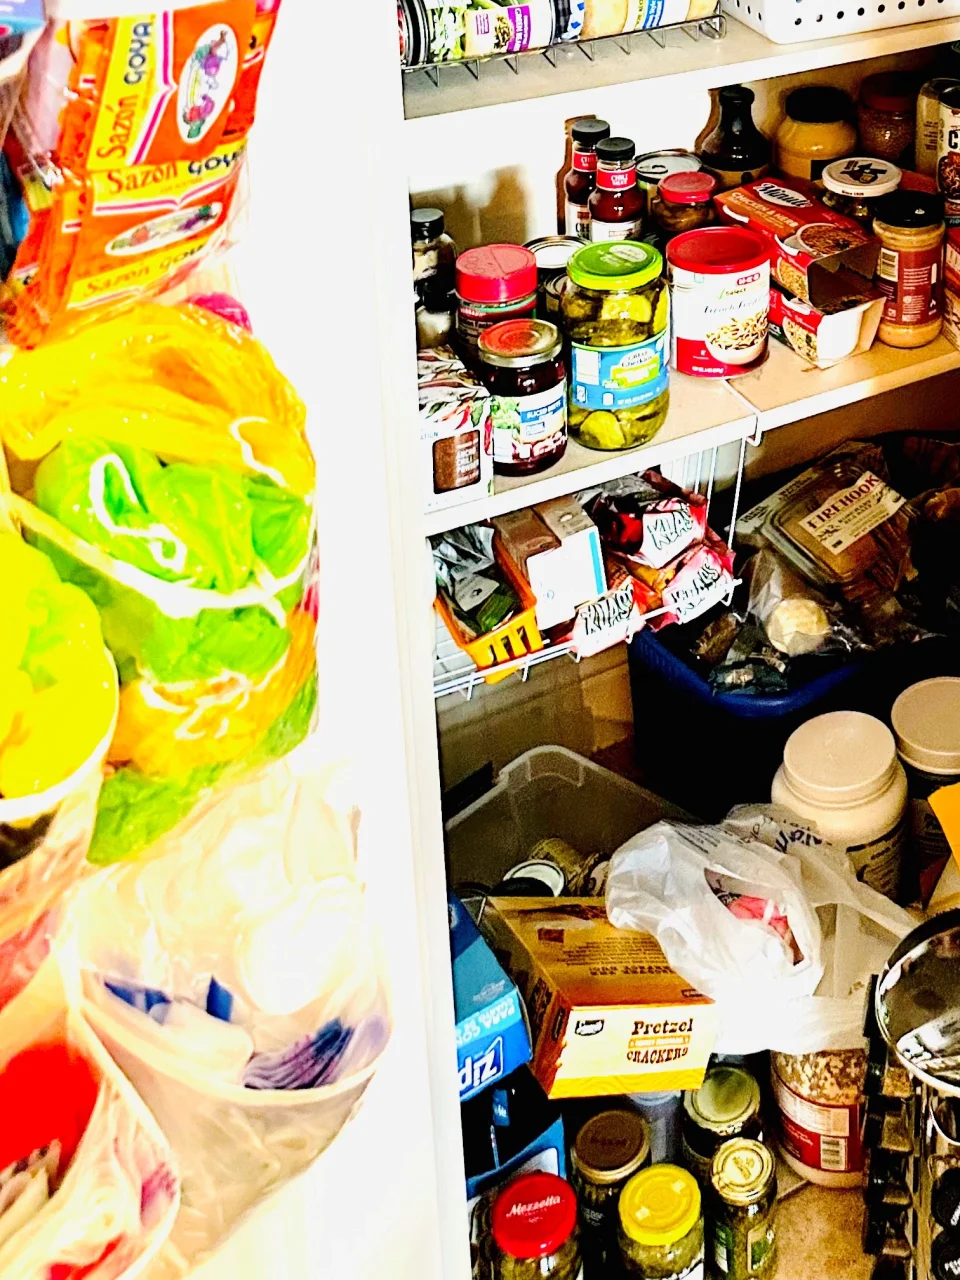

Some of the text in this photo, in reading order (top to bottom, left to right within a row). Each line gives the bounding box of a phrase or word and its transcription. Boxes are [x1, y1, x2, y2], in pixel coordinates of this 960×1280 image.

[97, 21, 152, 160] Sazón GOYA
[106, 162, 179, 195] Sazón
[731, 191, 769, 214] CHICKEN
[526, 408, 547, 419] SLICED
[806, 474, 880, 530] FIREHOOK
[631, 1017, 694, 1036] Pretzel
[626, 1047, 690, 1065] CRACKERS
